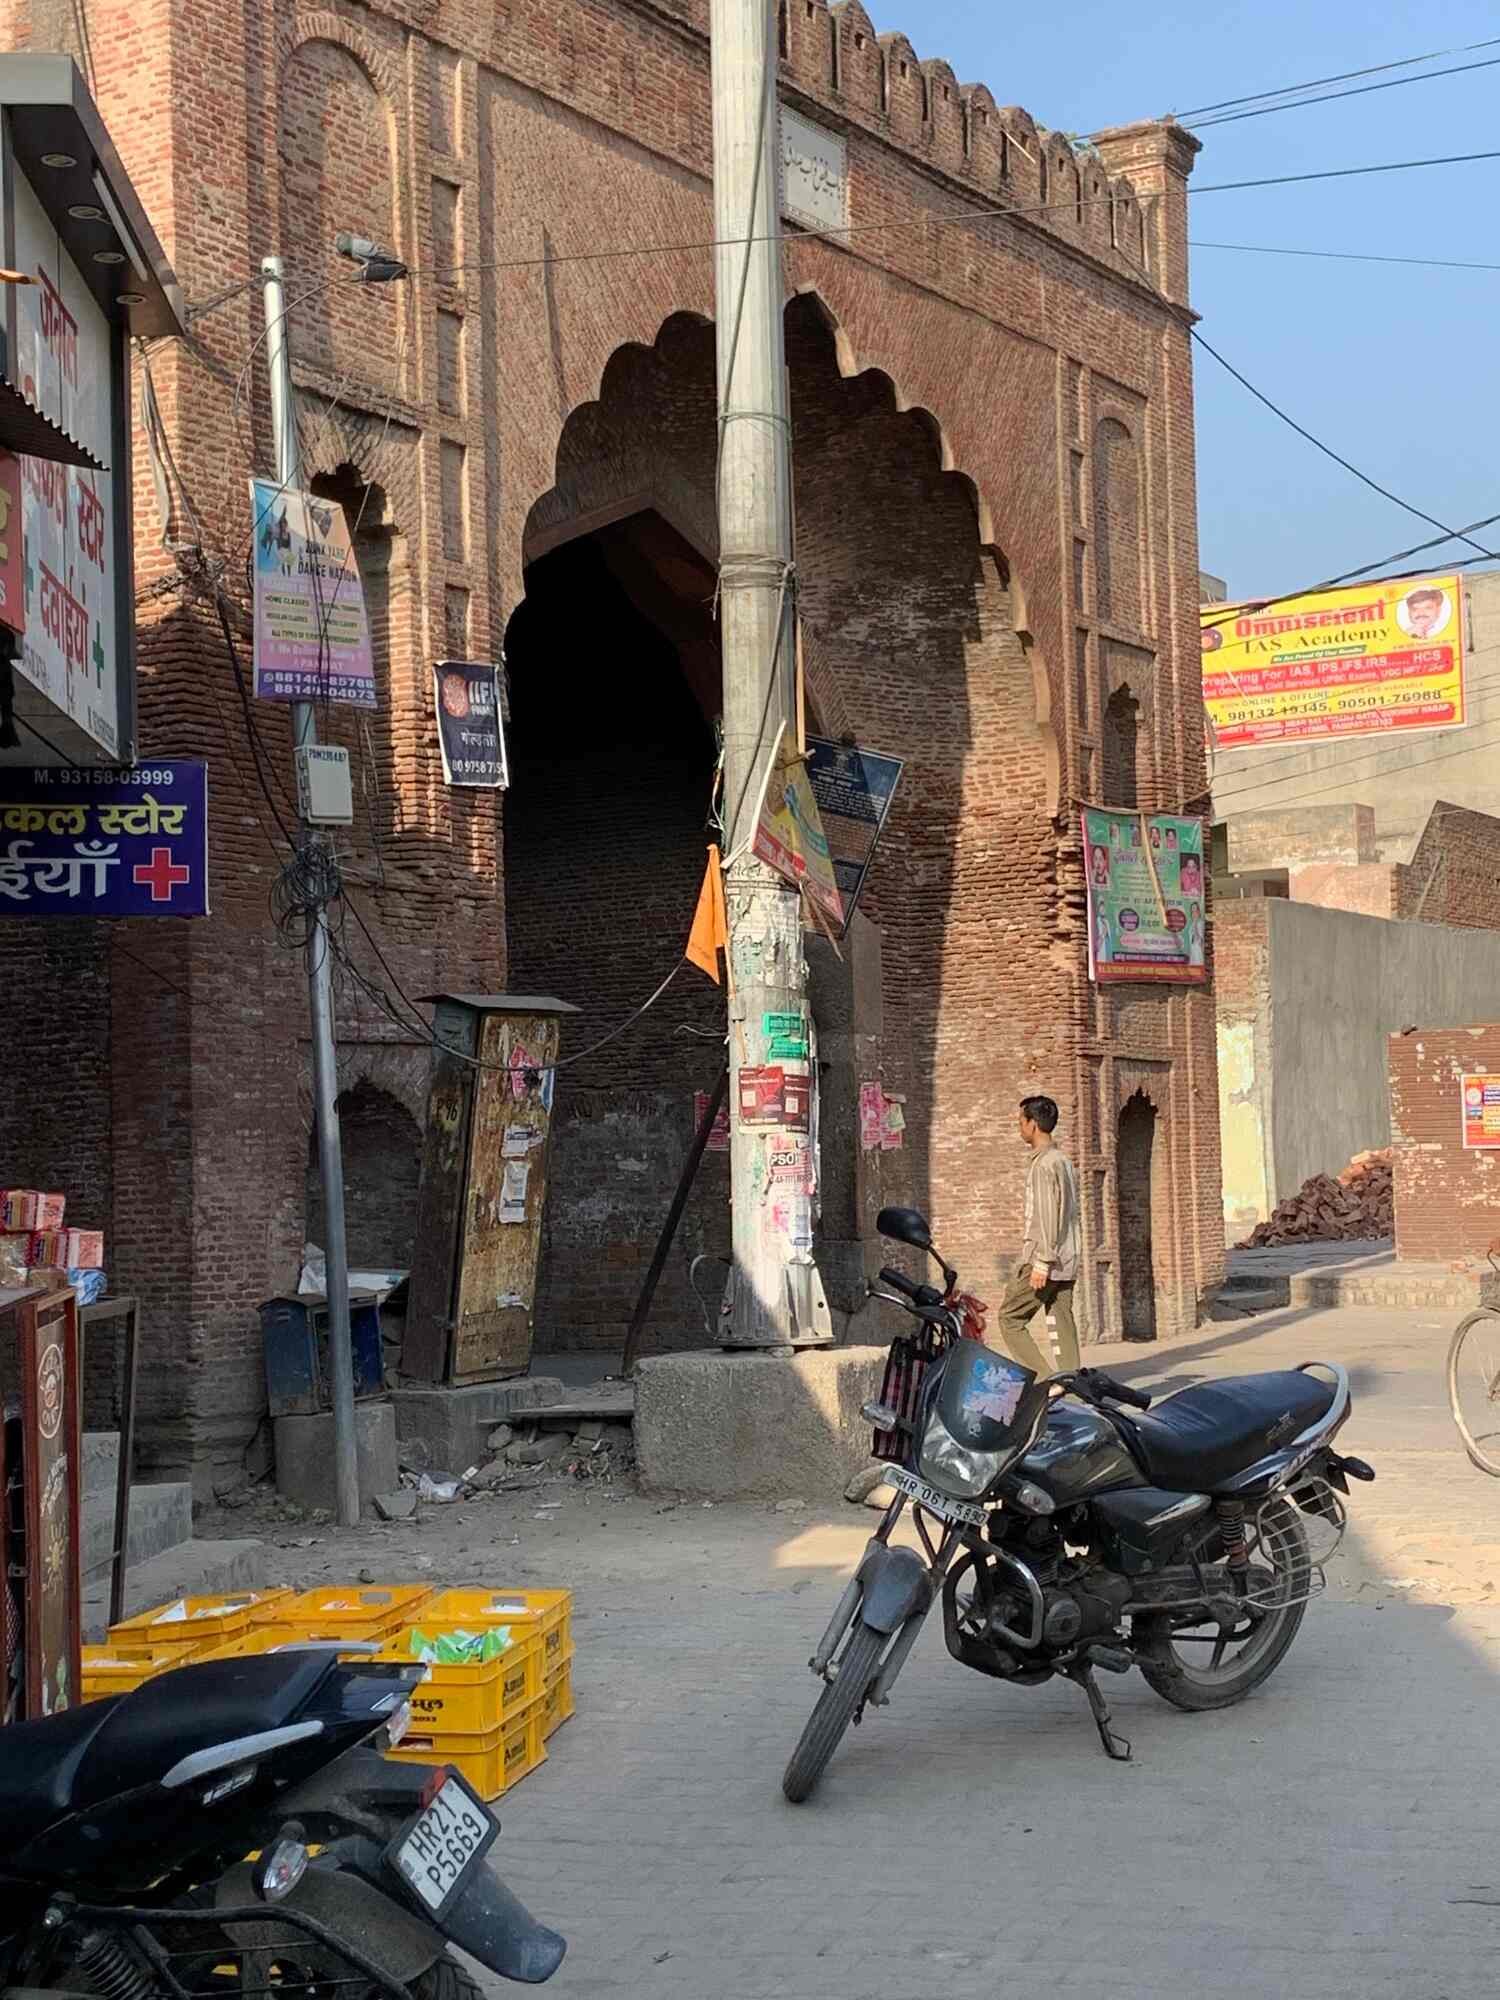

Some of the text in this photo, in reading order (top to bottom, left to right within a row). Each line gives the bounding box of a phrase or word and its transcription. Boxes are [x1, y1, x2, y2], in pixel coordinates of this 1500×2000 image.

[1236, 600, 1385, 637] Omniscient
[1244, 641, 1283, 654] IAS
[1298, 628, 1391, 649] Academy
[34, 769, 173, 785] M. 93158-05999
[97, 792, 188, 834] स्टोर
[408, 1796, 457, 1863] HR21
[427, 1812, 482, 1894] P5669
